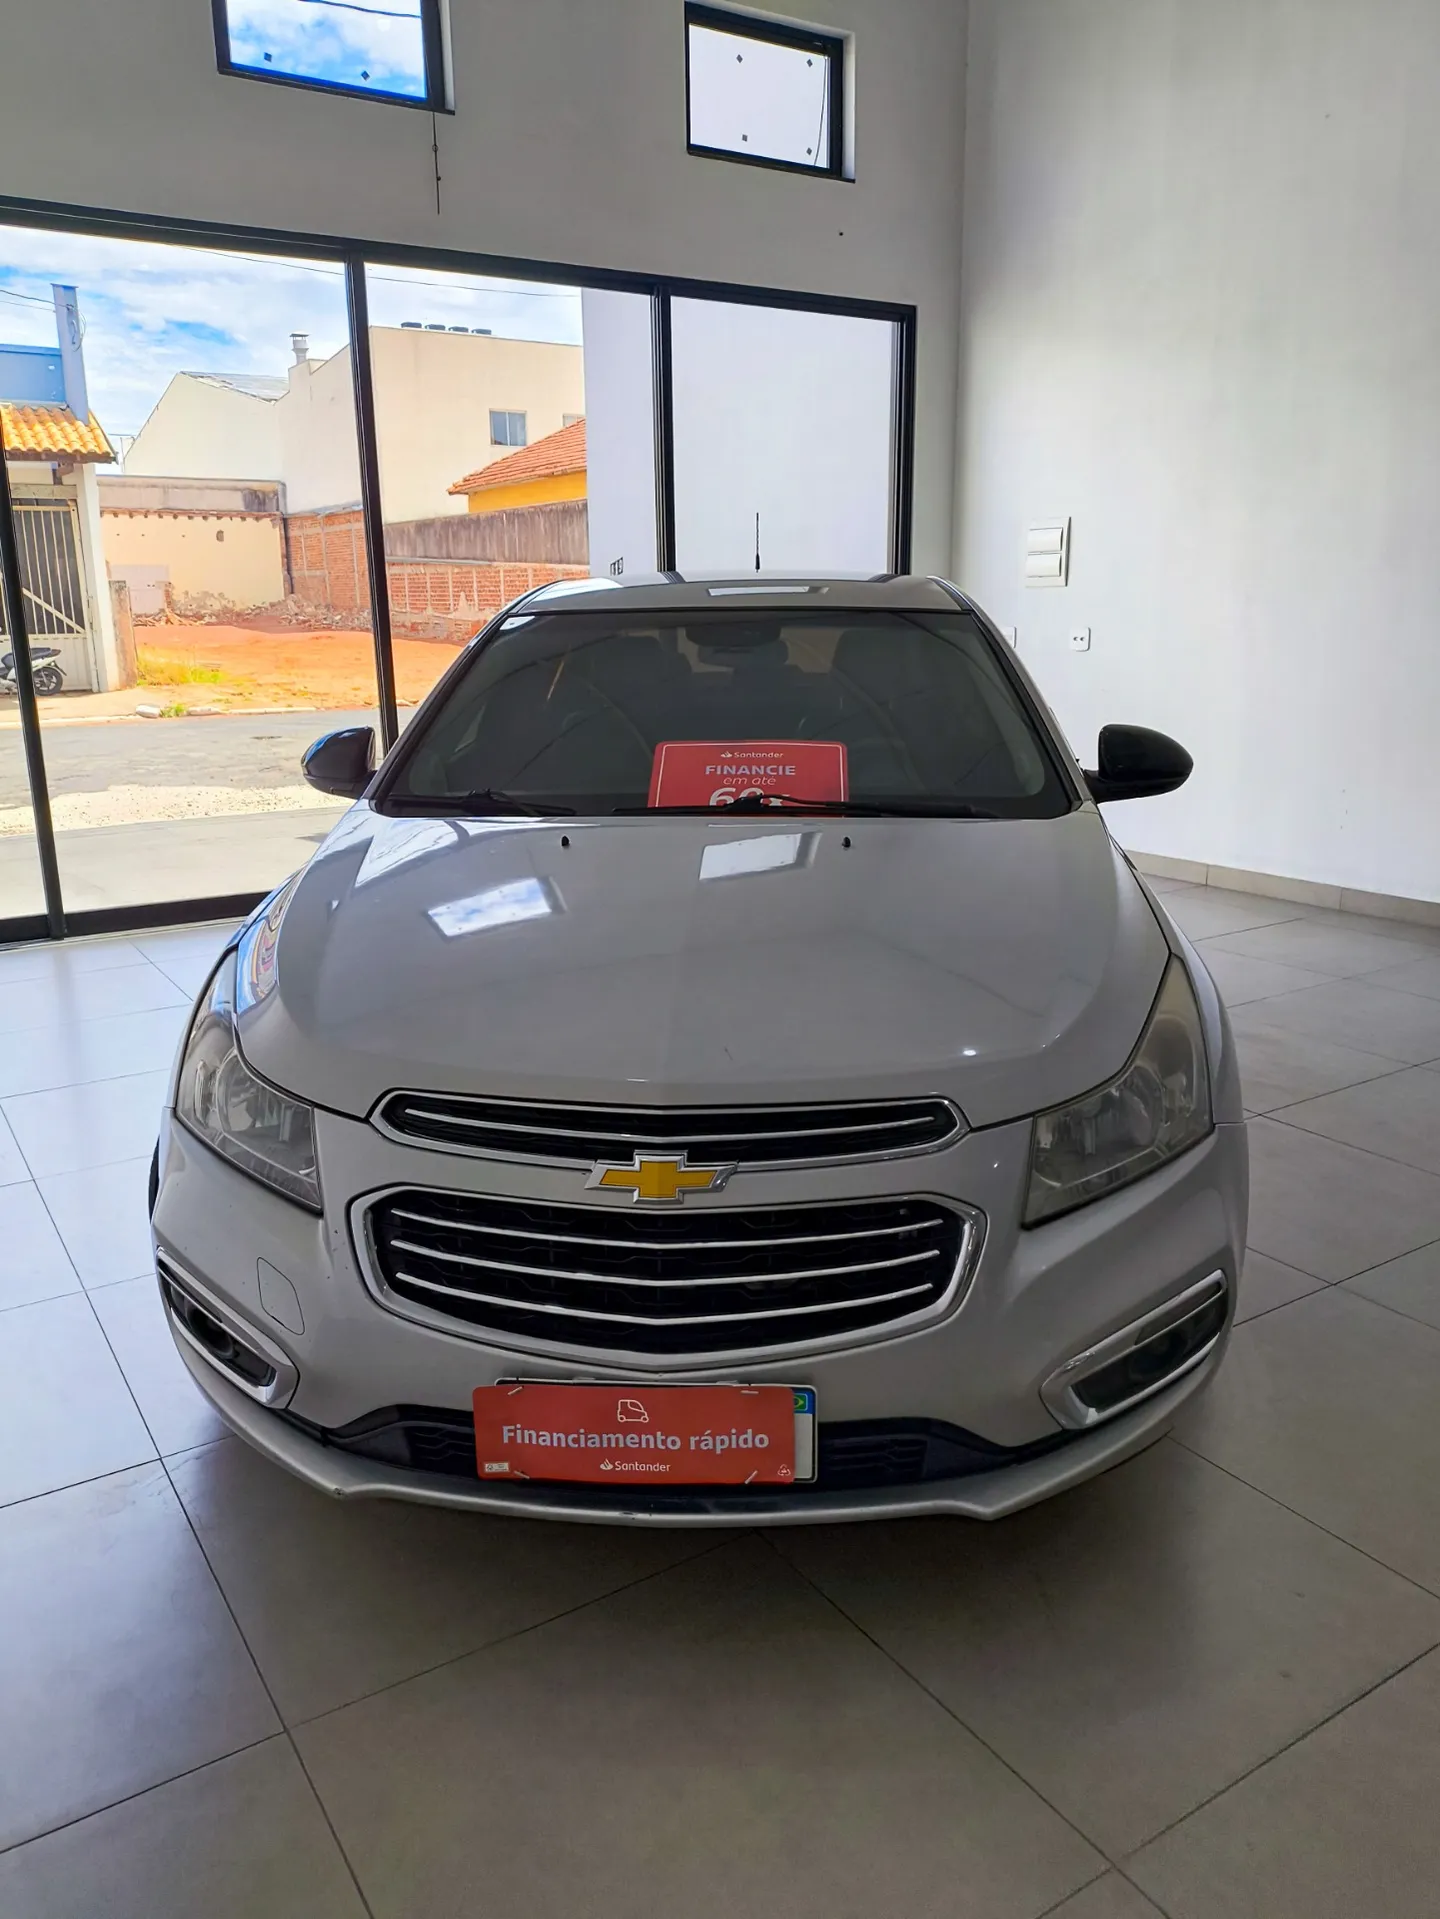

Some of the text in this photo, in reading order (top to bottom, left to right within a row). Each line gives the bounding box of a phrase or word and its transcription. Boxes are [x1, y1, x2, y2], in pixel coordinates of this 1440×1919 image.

[705, 765, 796, 776] FINANCIE
[723, 776, 776, 786] em até
[502, 1423, 770, 1454] Financiamento rápido
[614, 1460, 671, 1472] Santander
